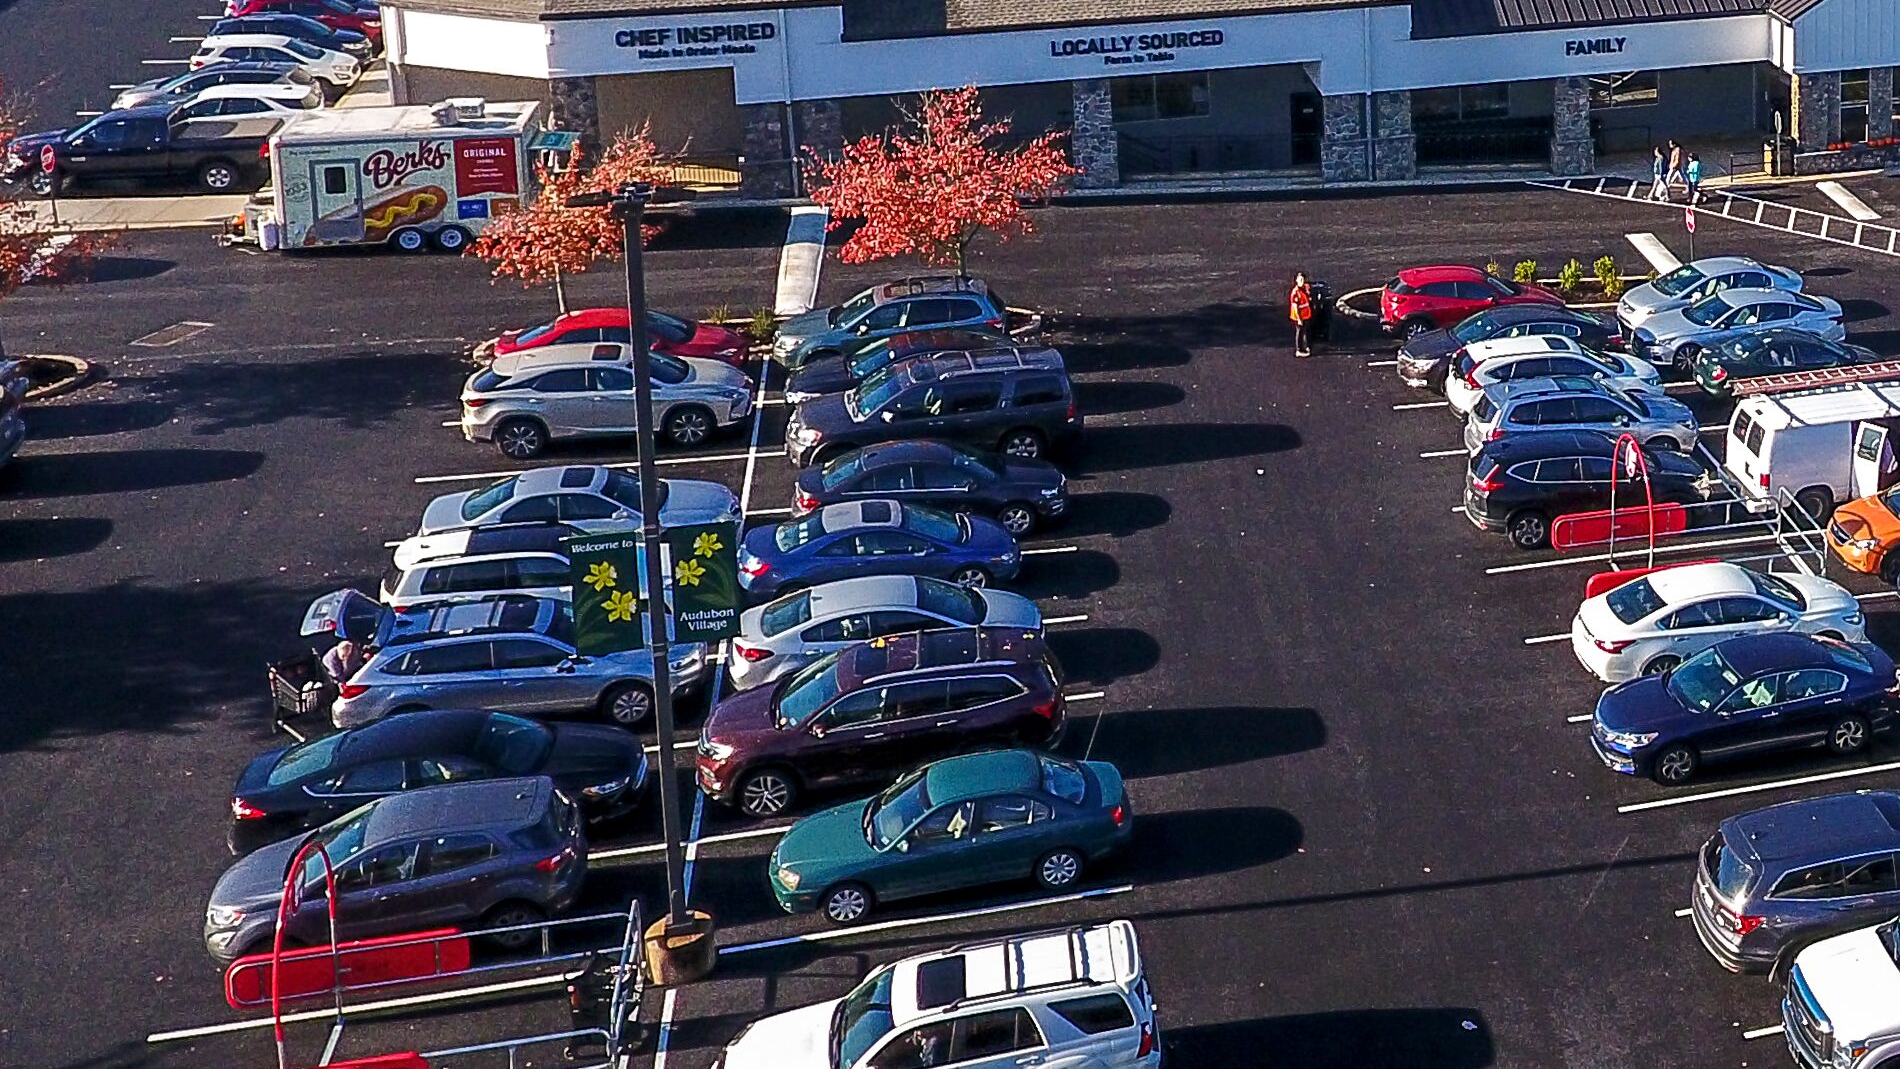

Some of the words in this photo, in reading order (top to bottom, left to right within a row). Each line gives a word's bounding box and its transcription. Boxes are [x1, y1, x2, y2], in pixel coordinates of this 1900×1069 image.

[615, 28, 671, 48] CHEF
[676, 22, 775, 45] INSPIRED
[1050, 35, 1135, 57] LOCALLY
[1138, 29, 1224, 51] SOURCED
[1565, 36, 1627, 56] FAMILY
[672, 47, 684, 57] to
[686, 45, 720, 57] Order
[1104, 54, 1132, 65] Farm
[1133, 53, 1145, 63] to
[1146, 51, 1175, 62] Table
[463, 147, 507, 158] ORIGINAL
[362, 139, 451, 190] Berks
[571, 540, 620, 554] Welcome
[621, 539, 634, 549] to
[679, 607, 735, 622] Audubon
[687, 619, 728, 632] Village
